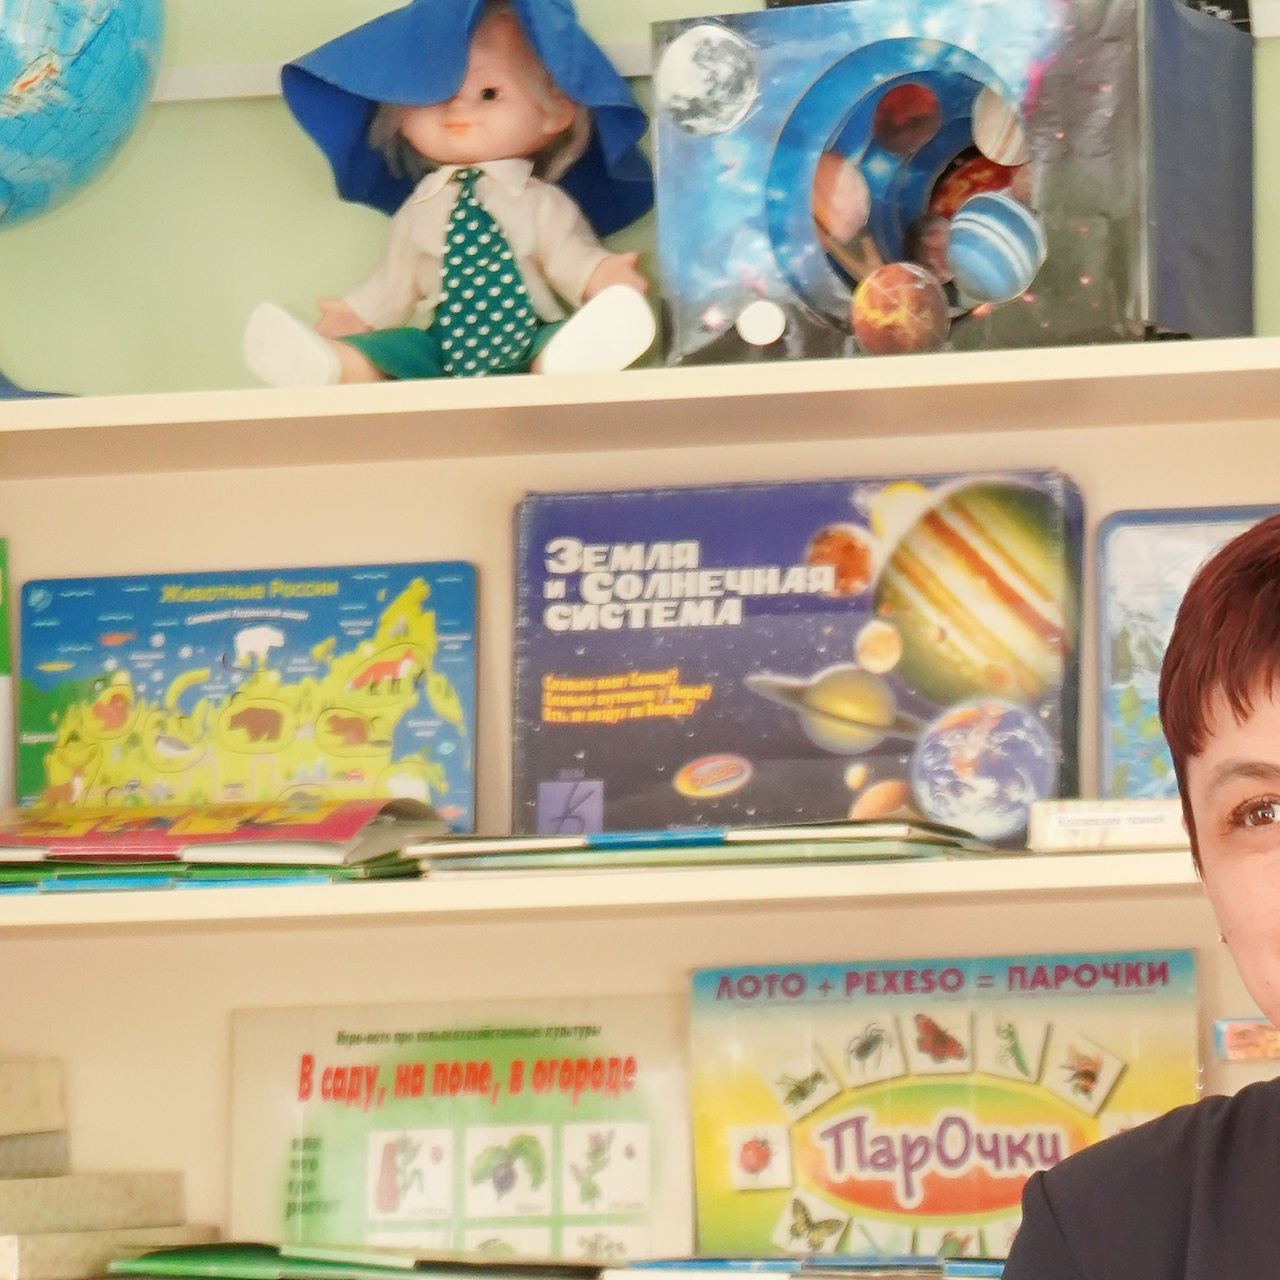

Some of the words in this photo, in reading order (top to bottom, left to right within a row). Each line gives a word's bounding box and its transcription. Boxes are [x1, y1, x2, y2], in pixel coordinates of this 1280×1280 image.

[268, 579, 339, 598] России
[715, 972, 806, 1000] ЛОТО
[845, 967, 965, 996] PEXESO
[1007, 961, 1170, 992] ПАРОЧКИ
[298, 1053, 314, 1102] В
[321, 1064, 386, 1113] саду,
[394, 1063, 425, 1099] на
[432, 1060, 500, 1108] поле,
[509, 1058, 525, 1096] в
[532, 1053, 637, 1108] огороде
[820, 1116, 1061, 1198] ПарОчки
